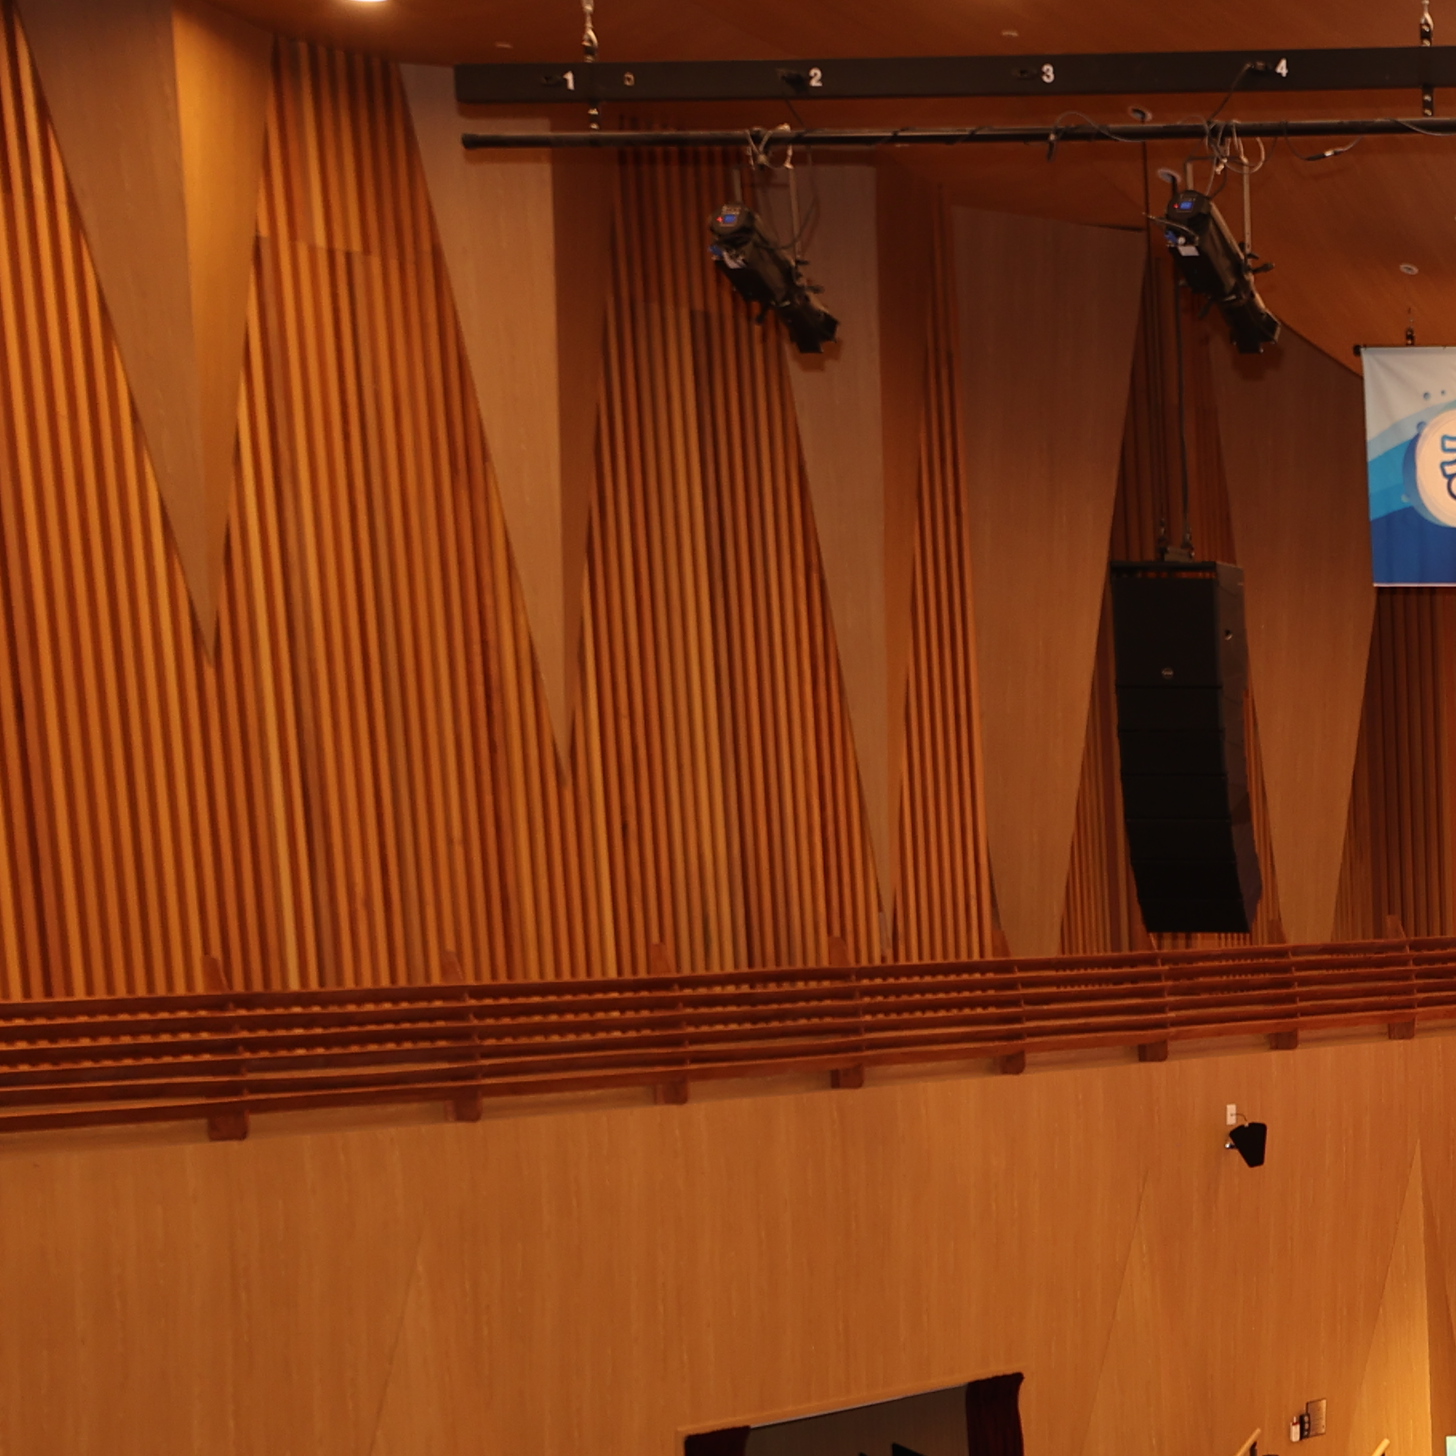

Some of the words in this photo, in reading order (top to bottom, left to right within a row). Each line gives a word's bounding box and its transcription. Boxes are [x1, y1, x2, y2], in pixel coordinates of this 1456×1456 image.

[808, 66, 823, 88] 2
[1040, 63, 1055, 84] 3
[1275, 57, 1288, 78] 4
[562, 70, 575, 90] 1
